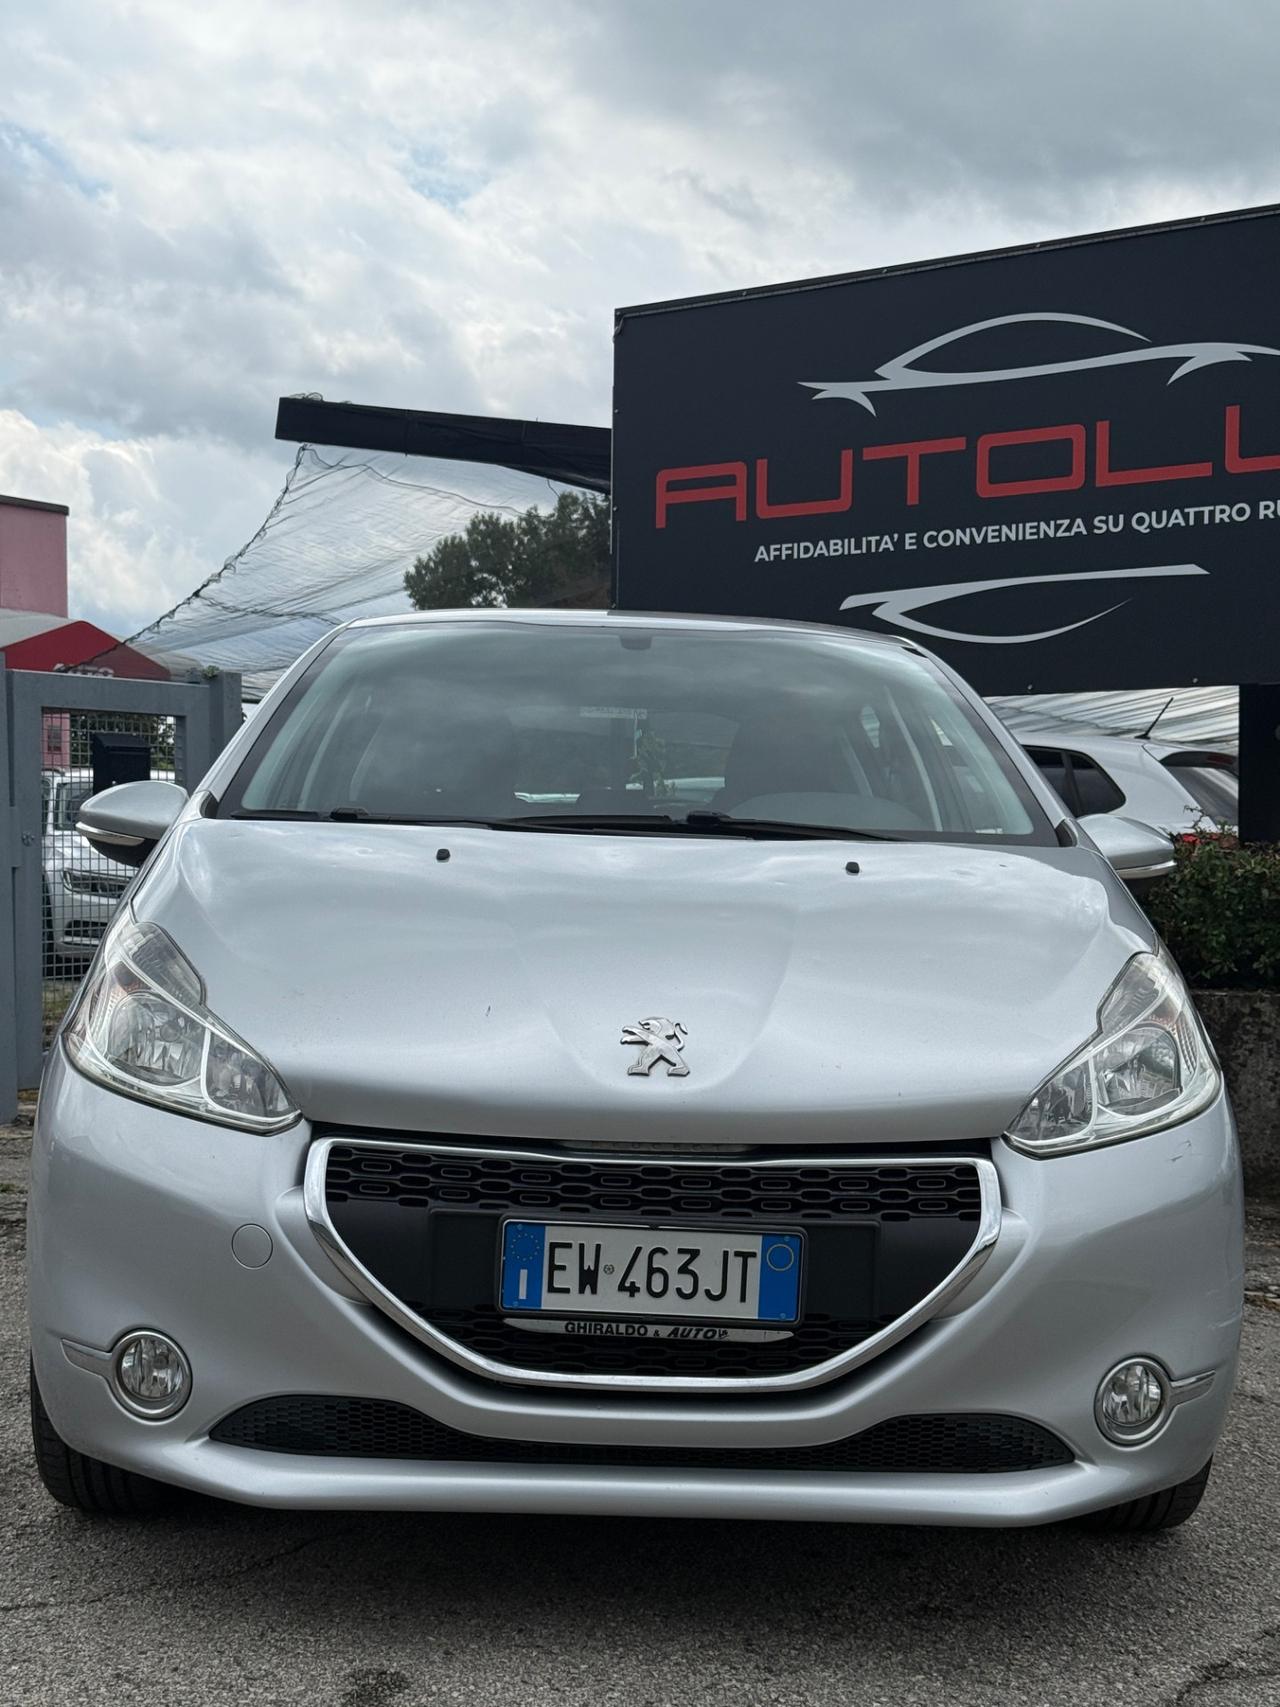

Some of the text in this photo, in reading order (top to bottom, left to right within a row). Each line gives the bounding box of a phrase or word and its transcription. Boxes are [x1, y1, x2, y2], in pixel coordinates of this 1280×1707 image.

[904, 532, 917, 550] E
[923, 515, 1087, 548] CONVENIENZA
[1093, 513, 1124, 534] SU
[1131, 502, 1251, 533] QUATTRO
[1258, 499, 1280, 520] R
[547, 1241, 758, 1303] EW 463JT
[564, 1321, 648, 1337] GHIRALDO
